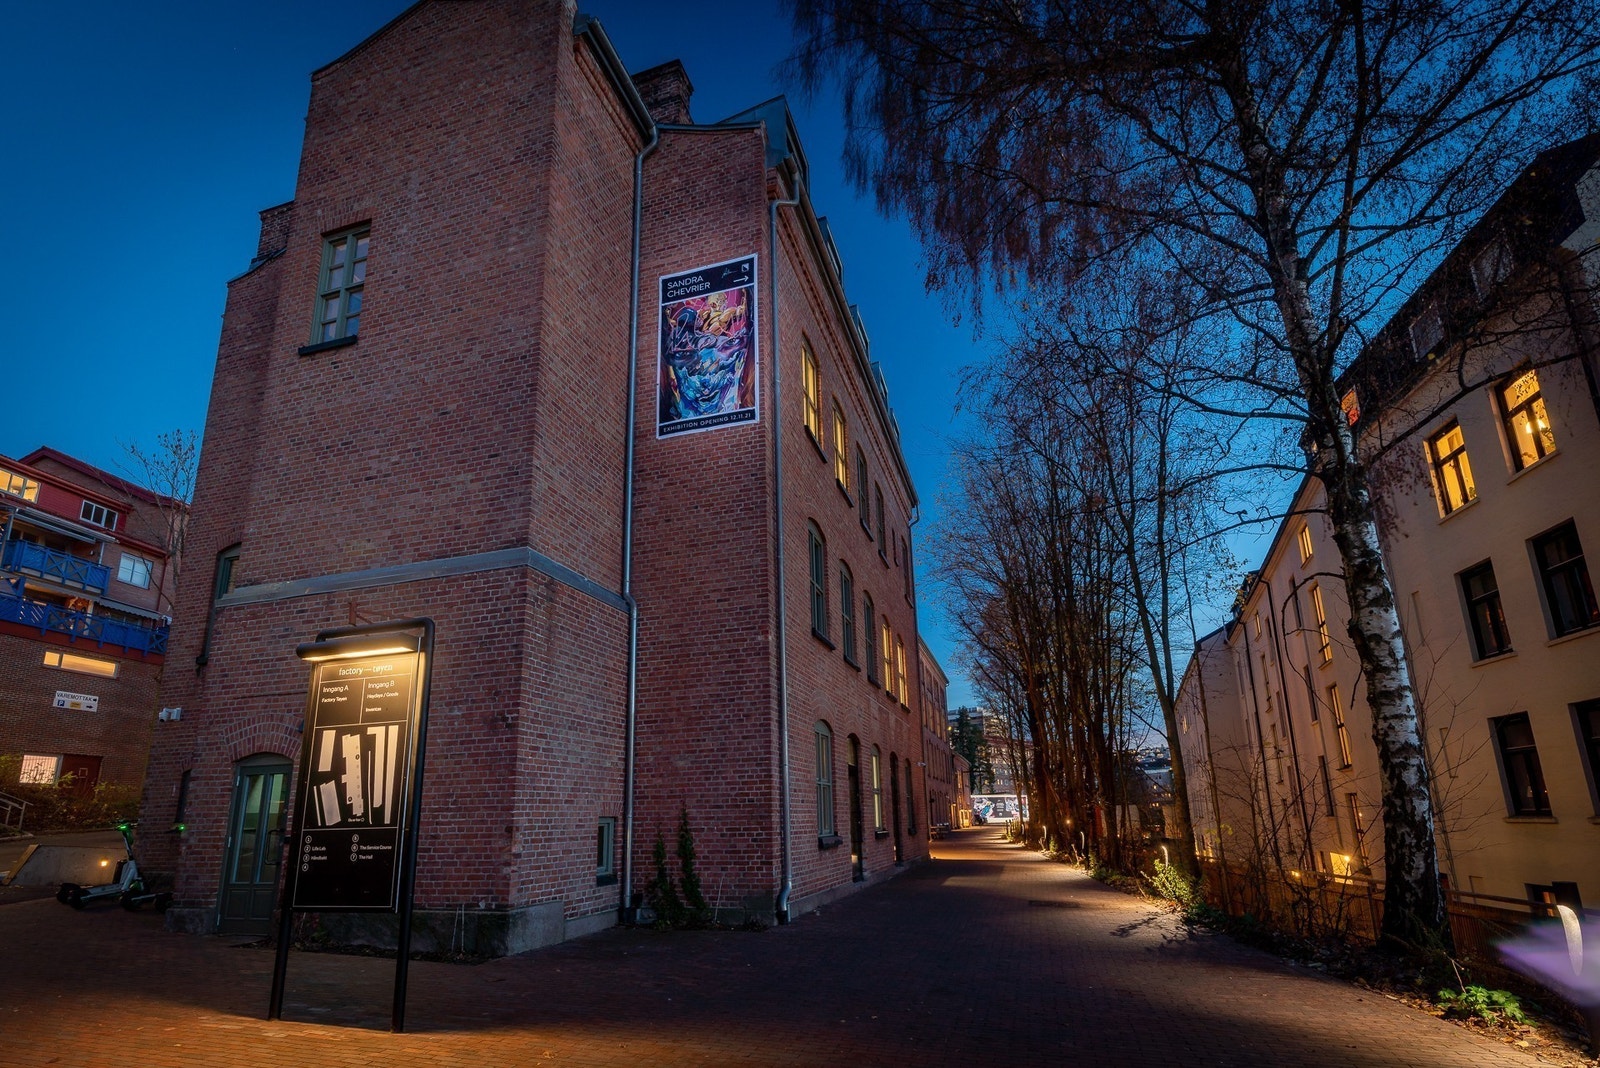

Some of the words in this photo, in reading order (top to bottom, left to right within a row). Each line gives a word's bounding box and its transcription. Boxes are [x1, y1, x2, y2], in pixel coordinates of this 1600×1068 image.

[667, 276, 704, 290] SANDRA
[666, 282, 711, 298] CHEVRIER
[663, 422, 698, 432] EXHIBITION
[700, 416, 729, 426] OPENING
[730, 412, 751, 420] 12.11.21
[338, 666, 364, 676] factory
[323, 686, 344, 694] Inngang
[368, 682, 390, 690] Inngang
[56, 692, 92, 701] VAREMOTTAK
